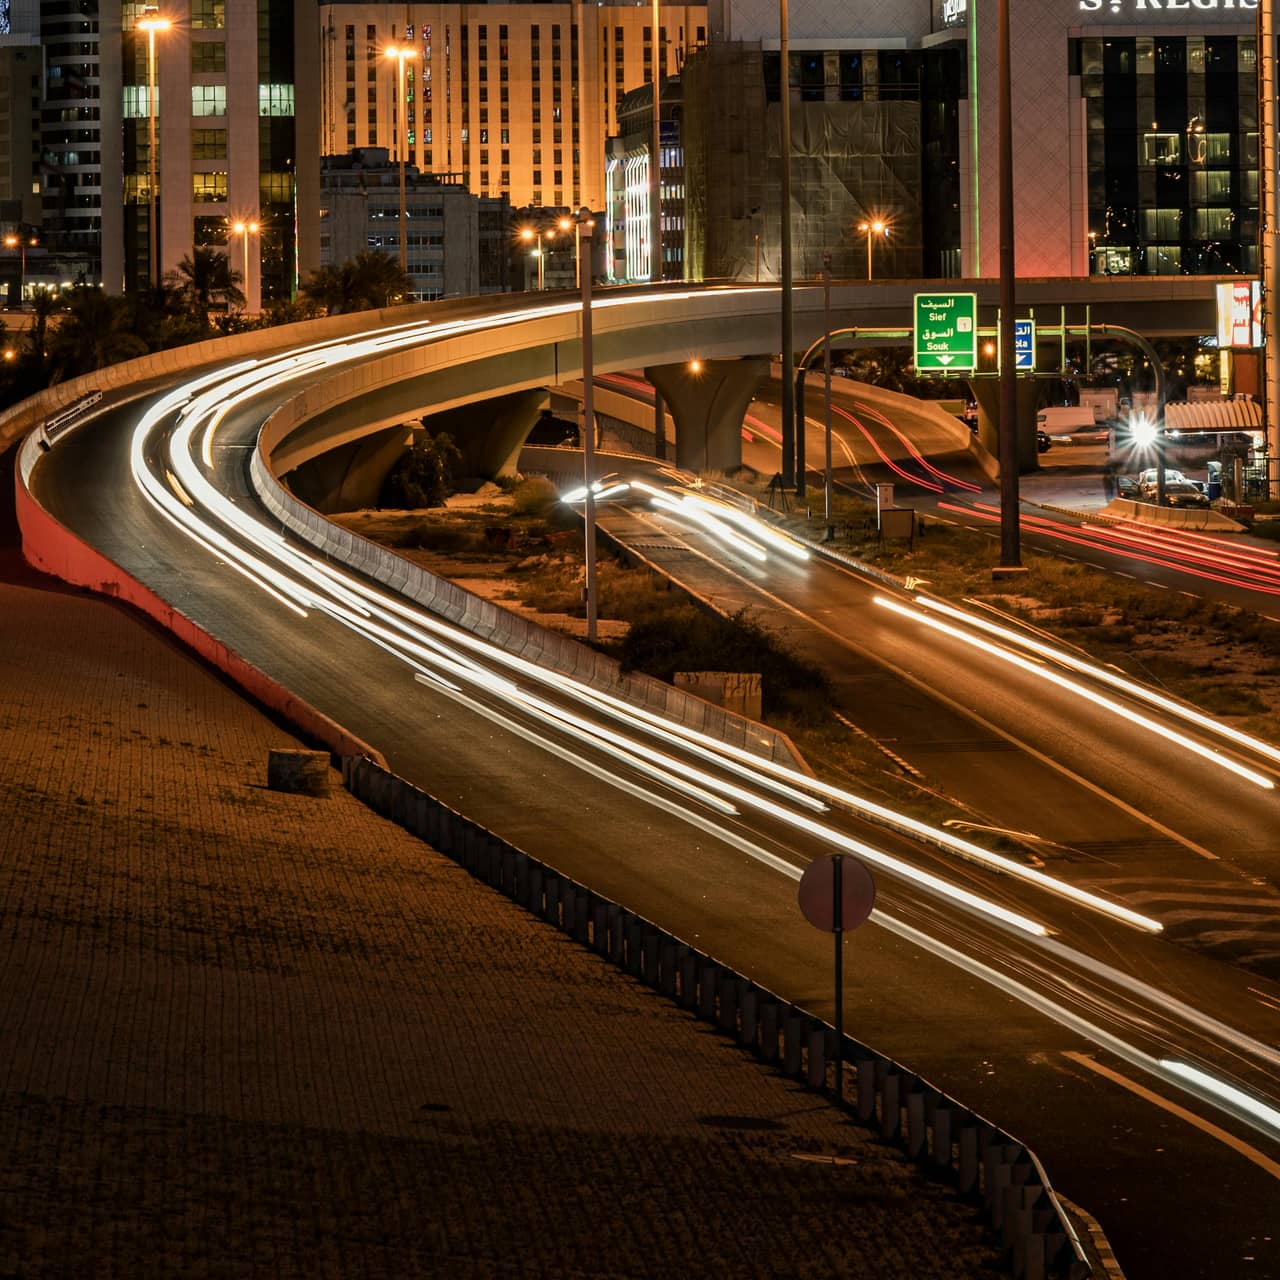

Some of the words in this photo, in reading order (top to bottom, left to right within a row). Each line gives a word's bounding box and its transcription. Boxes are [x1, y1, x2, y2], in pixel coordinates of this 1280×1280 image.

[920, 299, 954, 309] السيف
[929, 312, 947, 322] Sief
[922, 328, 954, 341] السوق
[926, 342, 949, 351] Souk
